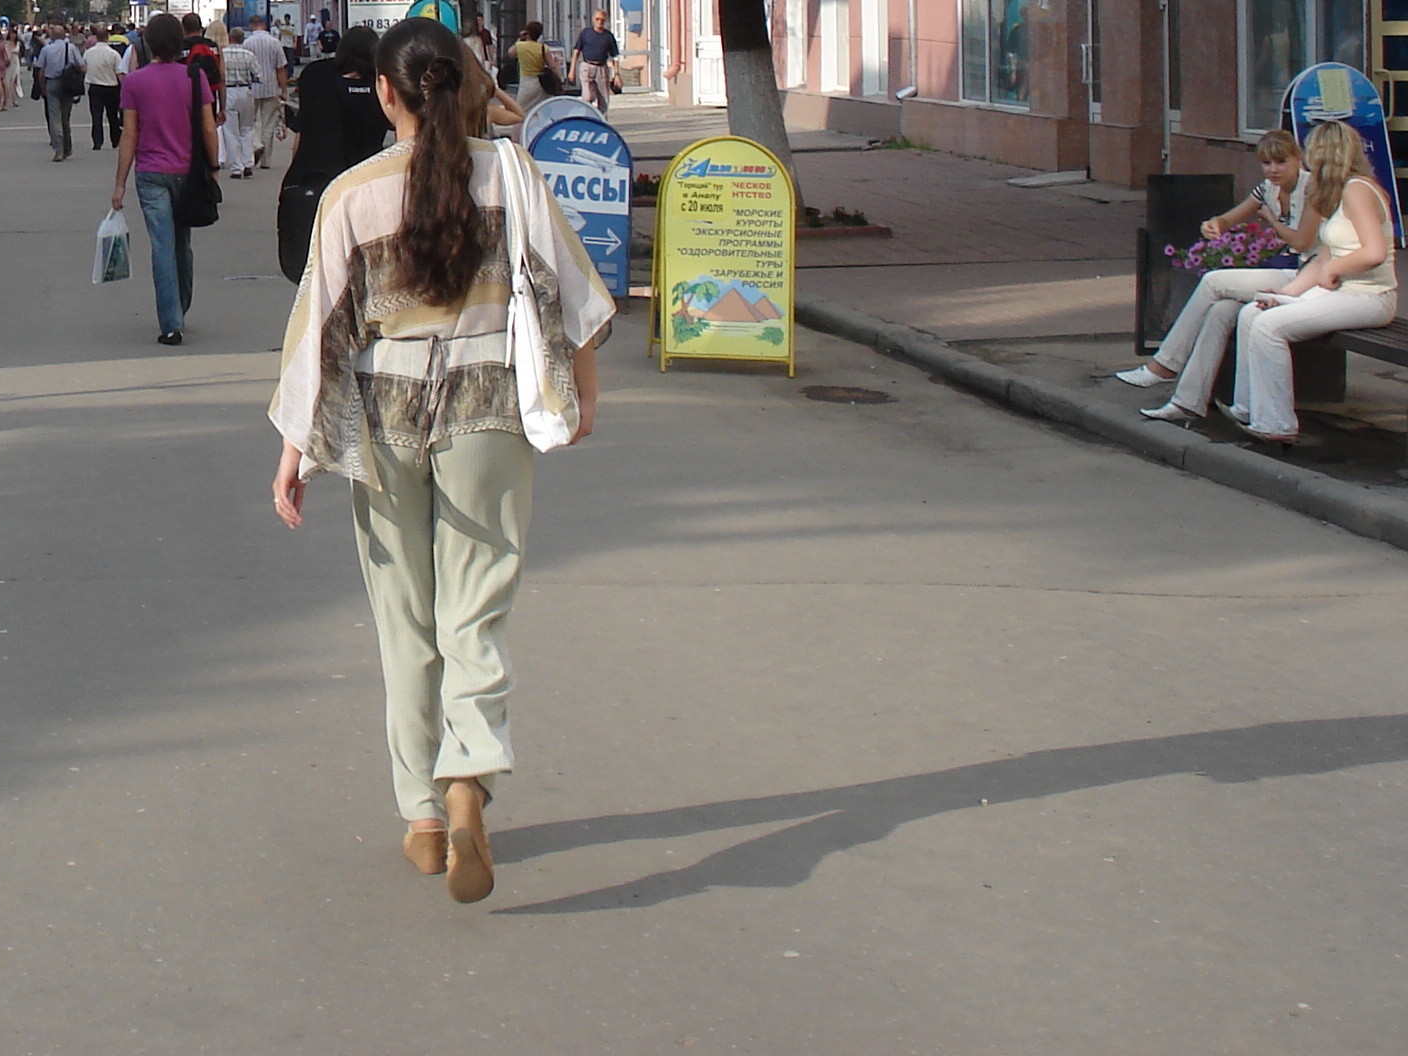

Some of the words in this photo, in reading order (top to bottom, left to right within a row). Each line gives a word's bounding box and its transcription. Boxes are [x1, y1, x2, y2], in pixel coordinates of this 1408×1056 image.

[551, 128, 609, 145] АВИА
[731, 182, 772, 190] ЧЕСКОЕ
[732, 191, 772, 199] НТСТВО
[688, 200, 698, 212] 20
[700, 203, 724, 213] июля
[736, 219, 783, 228] КУРОРТЫ
[719, 239, 783, 248] ПРОГРАММЫ
[756, 260, 783, 268] ТУРЫ
[742, 280, 783, 289] РОССИЯ
